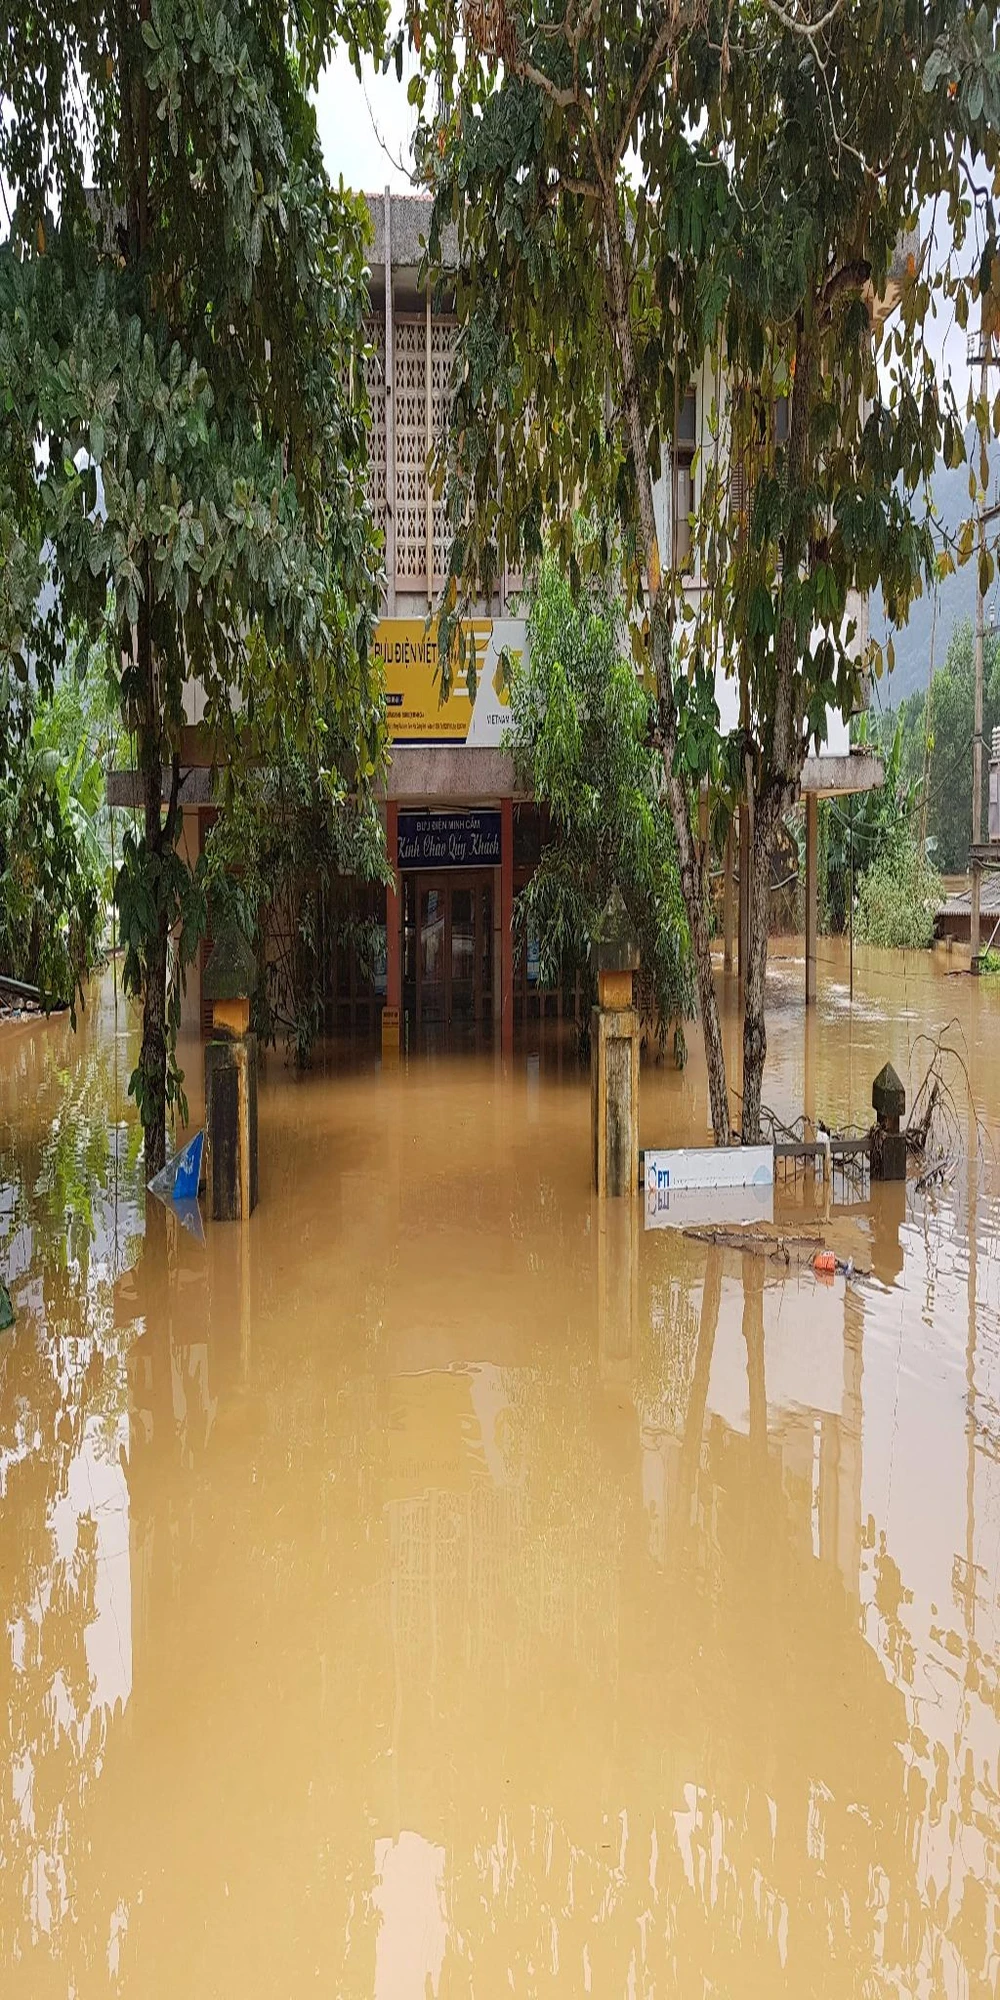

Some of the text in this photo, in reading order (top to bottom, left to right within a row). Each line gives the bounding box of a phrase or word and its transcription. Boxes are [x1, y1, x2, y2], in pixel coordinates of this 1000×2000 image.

[395, 637, 417, 668] ĐIỆN
[418, 638, 437, 668] VIỆT
[416, 820, 431, 831] BƯU
[432, 818, 447, 833] ĐIỆN
[448, 820, 465, 831] MINH
[398, 833, 499, 861] Kính Chào Quý Khách
[657, 1170, 670, 1188] PTI
